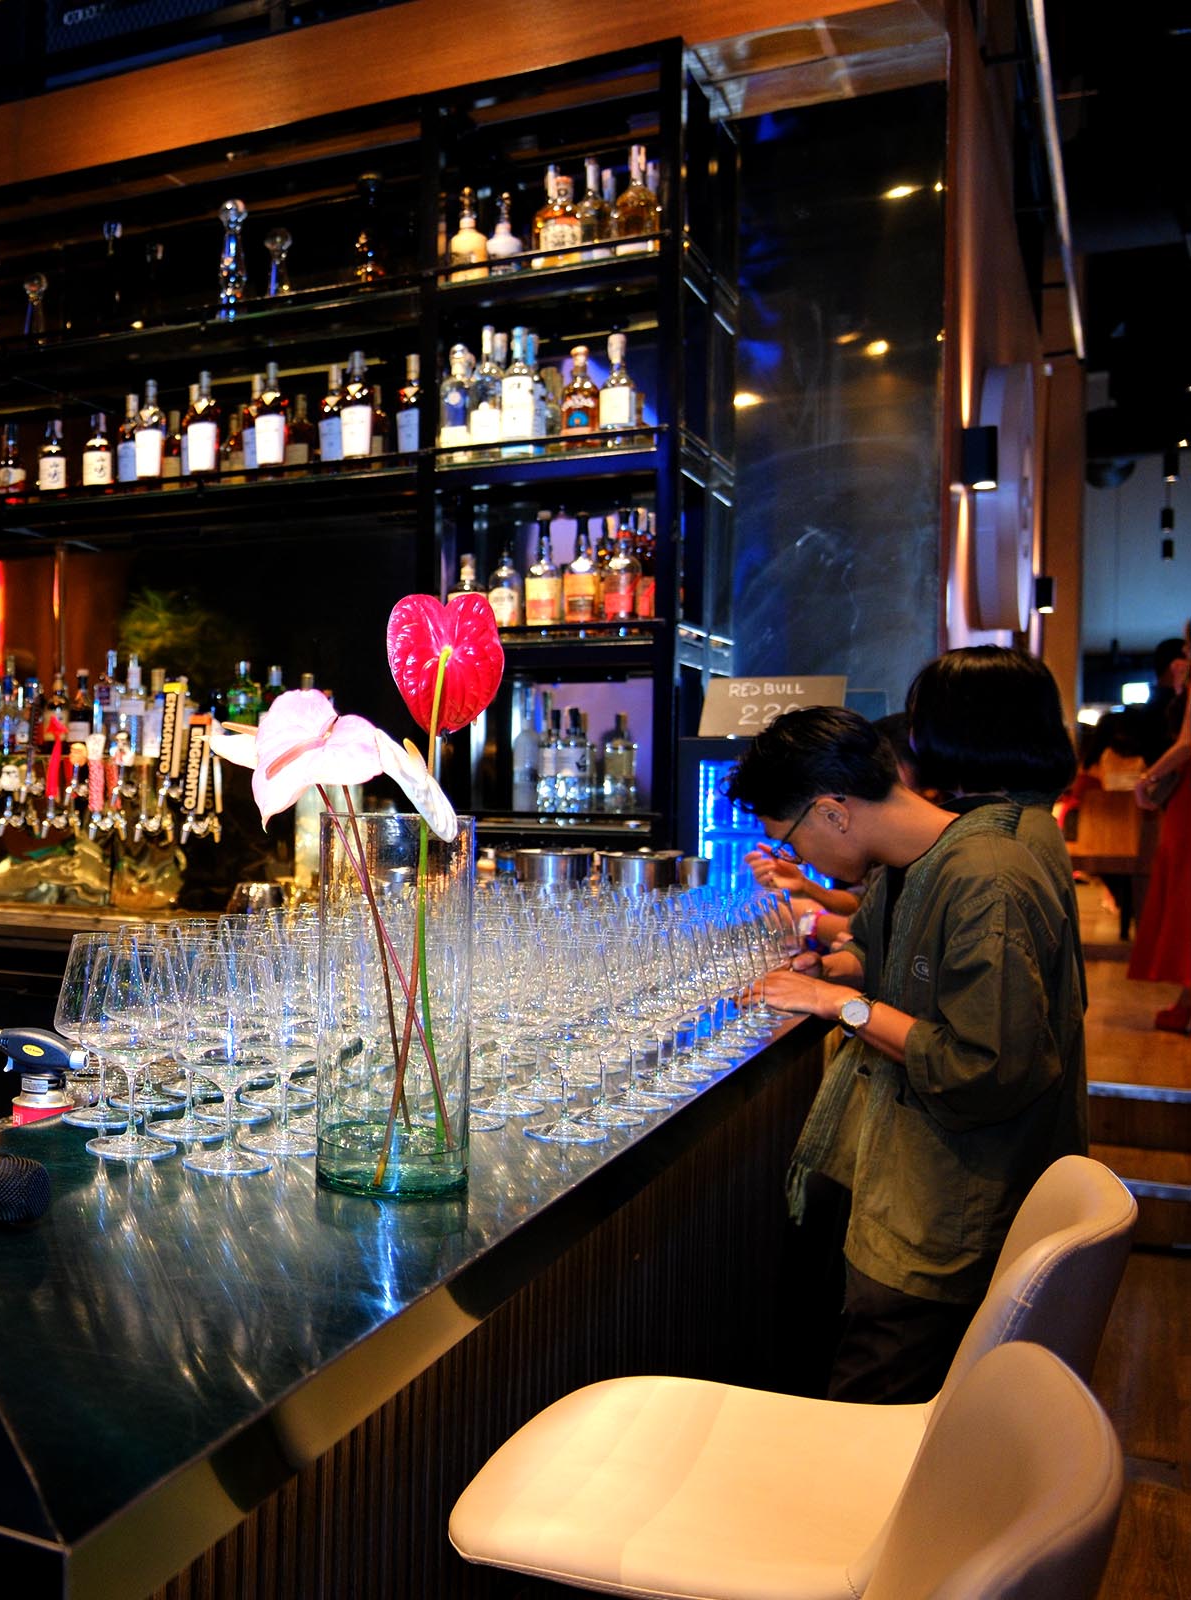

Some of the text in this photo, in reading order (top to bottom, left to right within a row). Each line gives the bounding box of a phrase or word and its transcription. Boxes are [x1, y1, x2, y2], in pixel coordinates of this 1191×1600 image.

[728, 682, 805, 698] RED BULL
[159, 692, 178, 774] ENGKANTO
